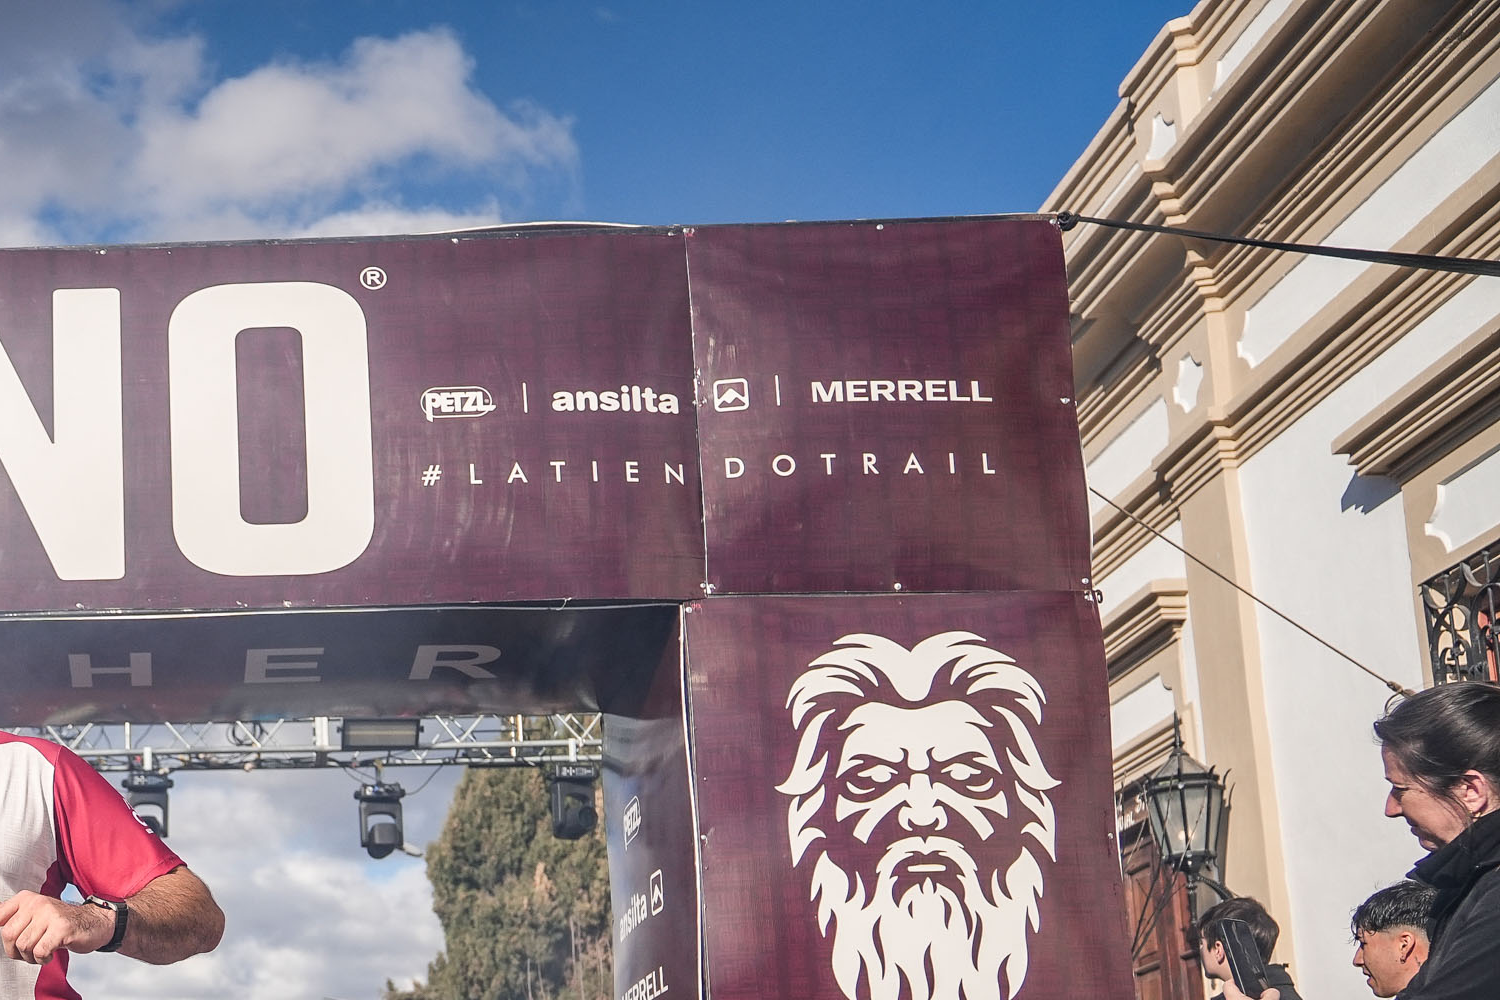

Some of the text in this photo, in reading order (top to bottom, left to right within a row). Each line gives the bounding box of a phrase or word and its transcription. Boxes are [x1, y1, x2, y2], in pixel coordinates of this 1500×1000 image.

[424, 380, 993, 422] PETZL ansilta MERRELL
[623, 801, 642, 850] PETZL
[619, 892, 648, 943] ansilta
